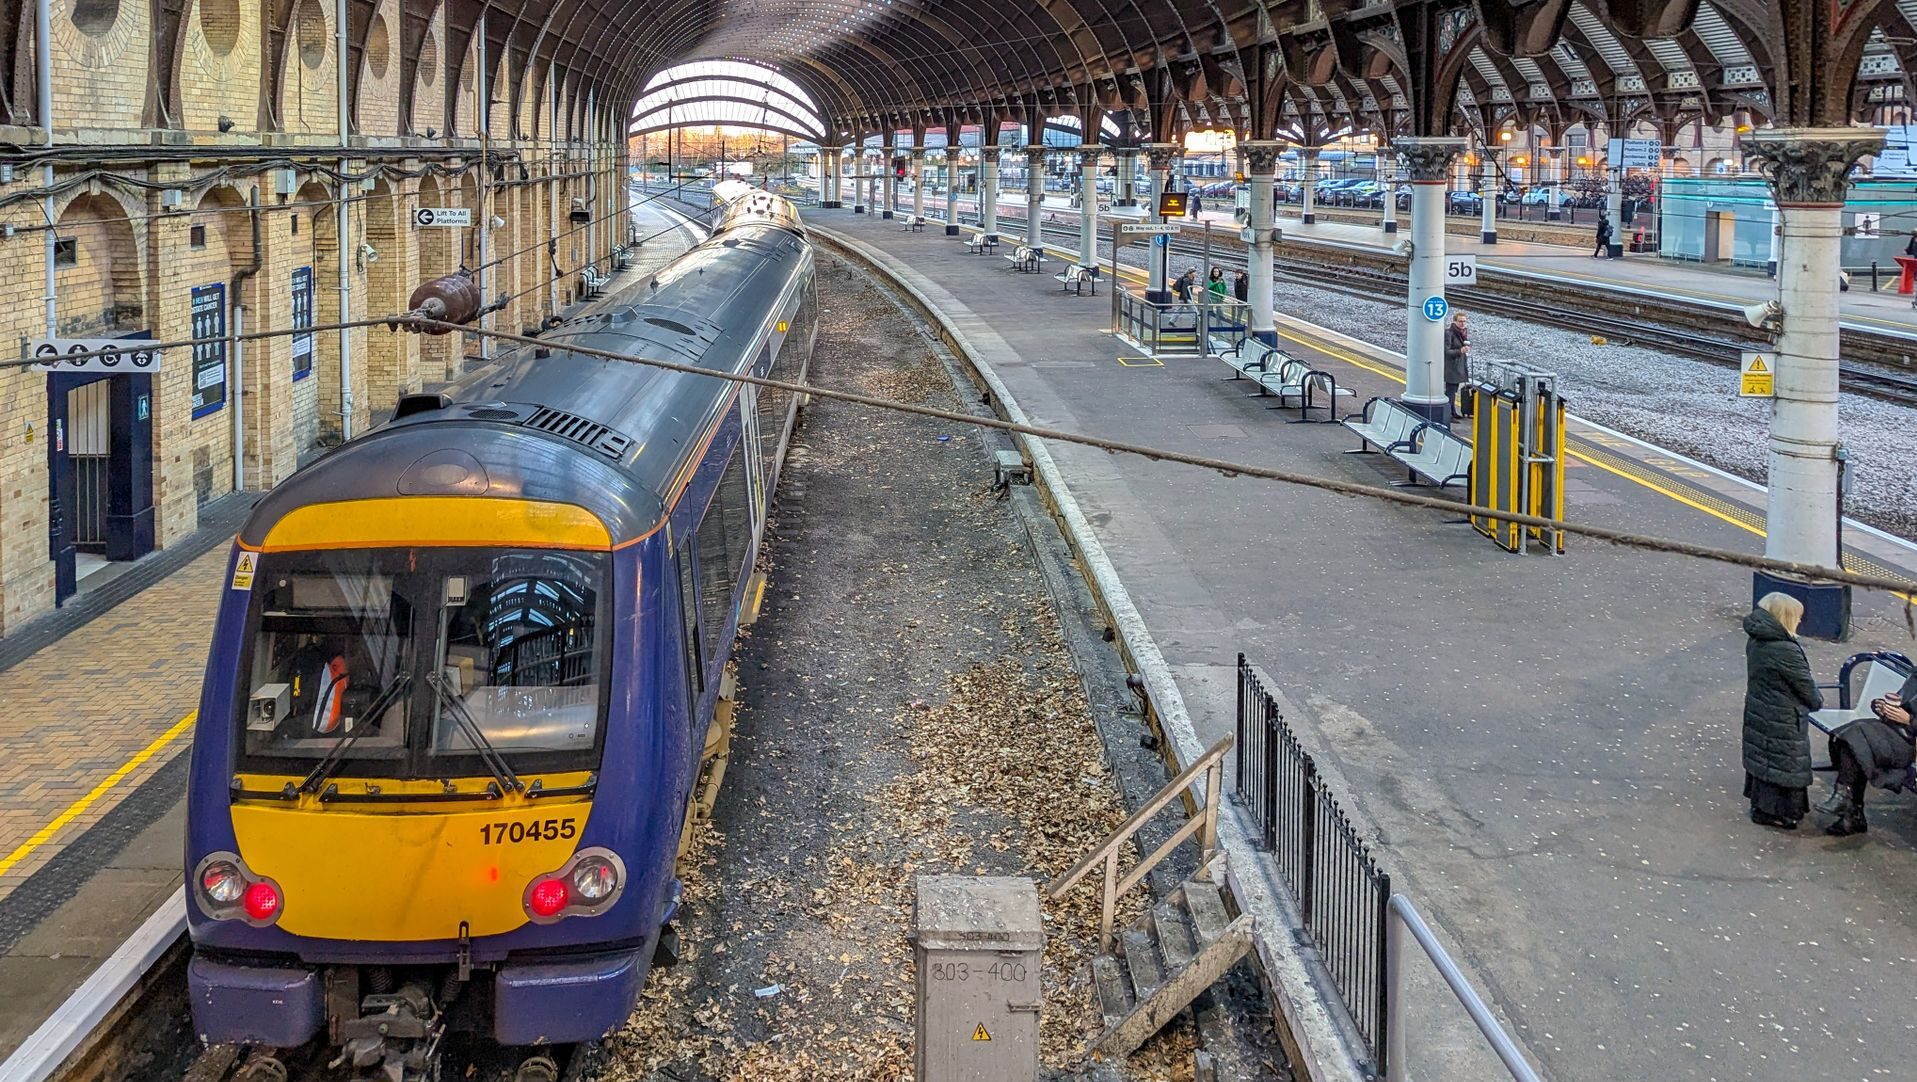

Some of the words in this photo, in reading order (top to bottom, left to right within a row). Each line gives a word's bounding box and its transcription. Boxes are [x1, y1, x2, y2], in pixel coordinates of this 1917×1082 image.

[1448, 262, 1472, 277] 5b
[1427, 304, 1444, 316] 13
[480, 818, 576, 845] 170455
